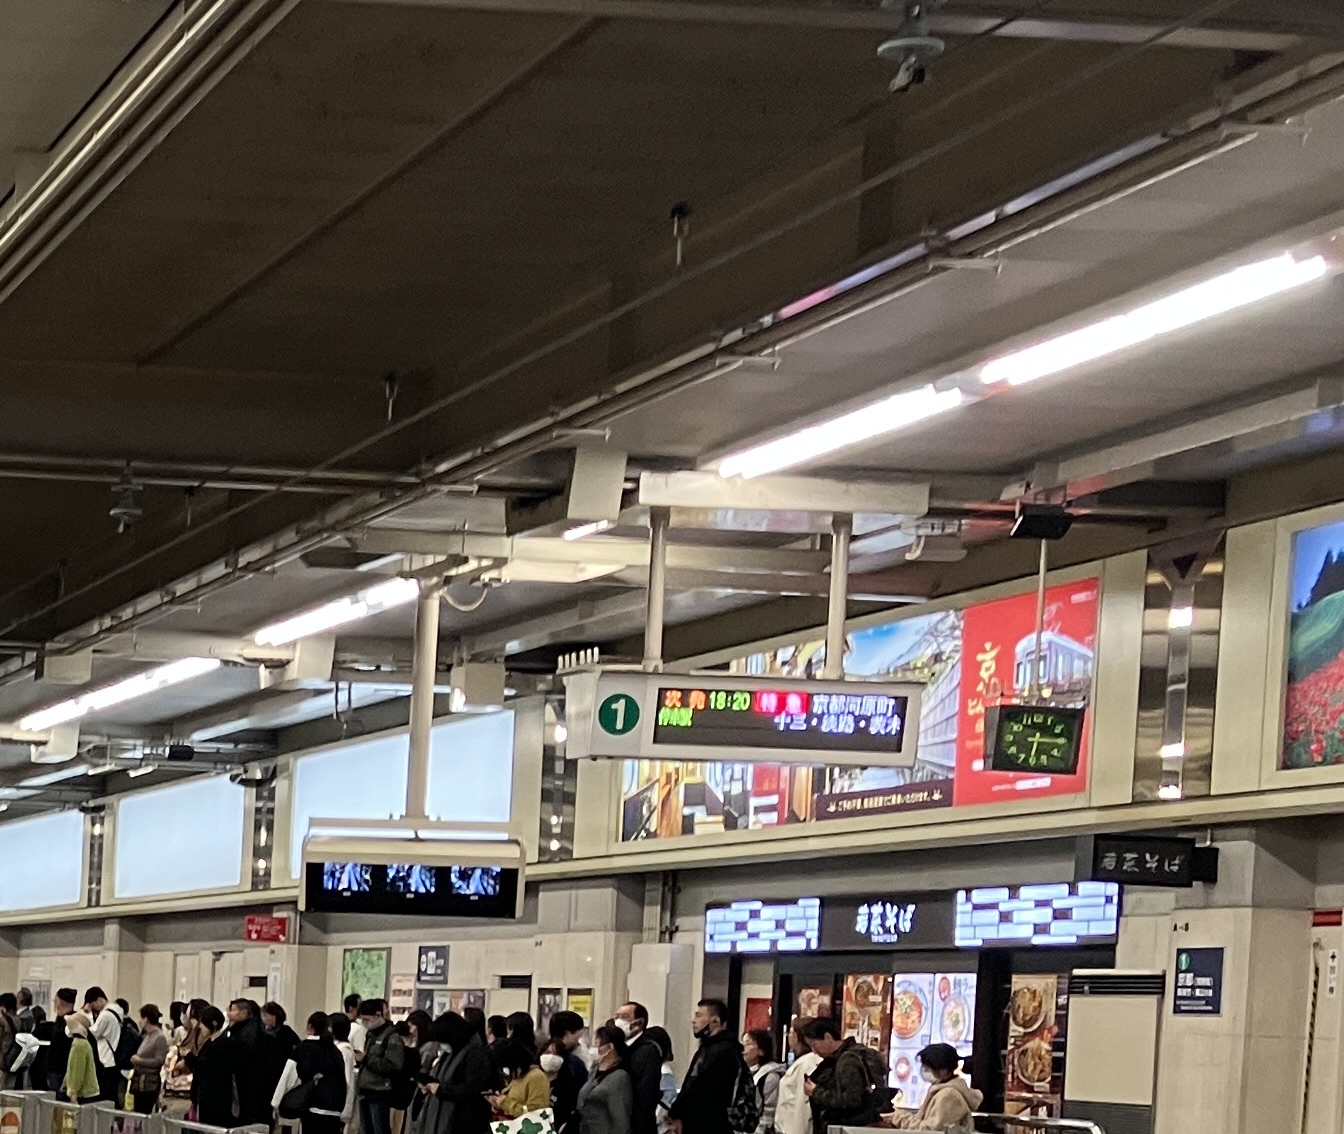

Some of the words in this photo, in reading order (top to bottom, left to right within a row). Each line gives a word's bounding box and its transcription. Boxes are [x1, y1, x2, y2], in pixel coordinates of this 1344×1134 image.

[611, 698, 626, 730] 1
[709, 690, 751, 711] 18:20
[812, 694, 897, 717] 京都河原町
[855, 900, 916, 935] 若菜そば
